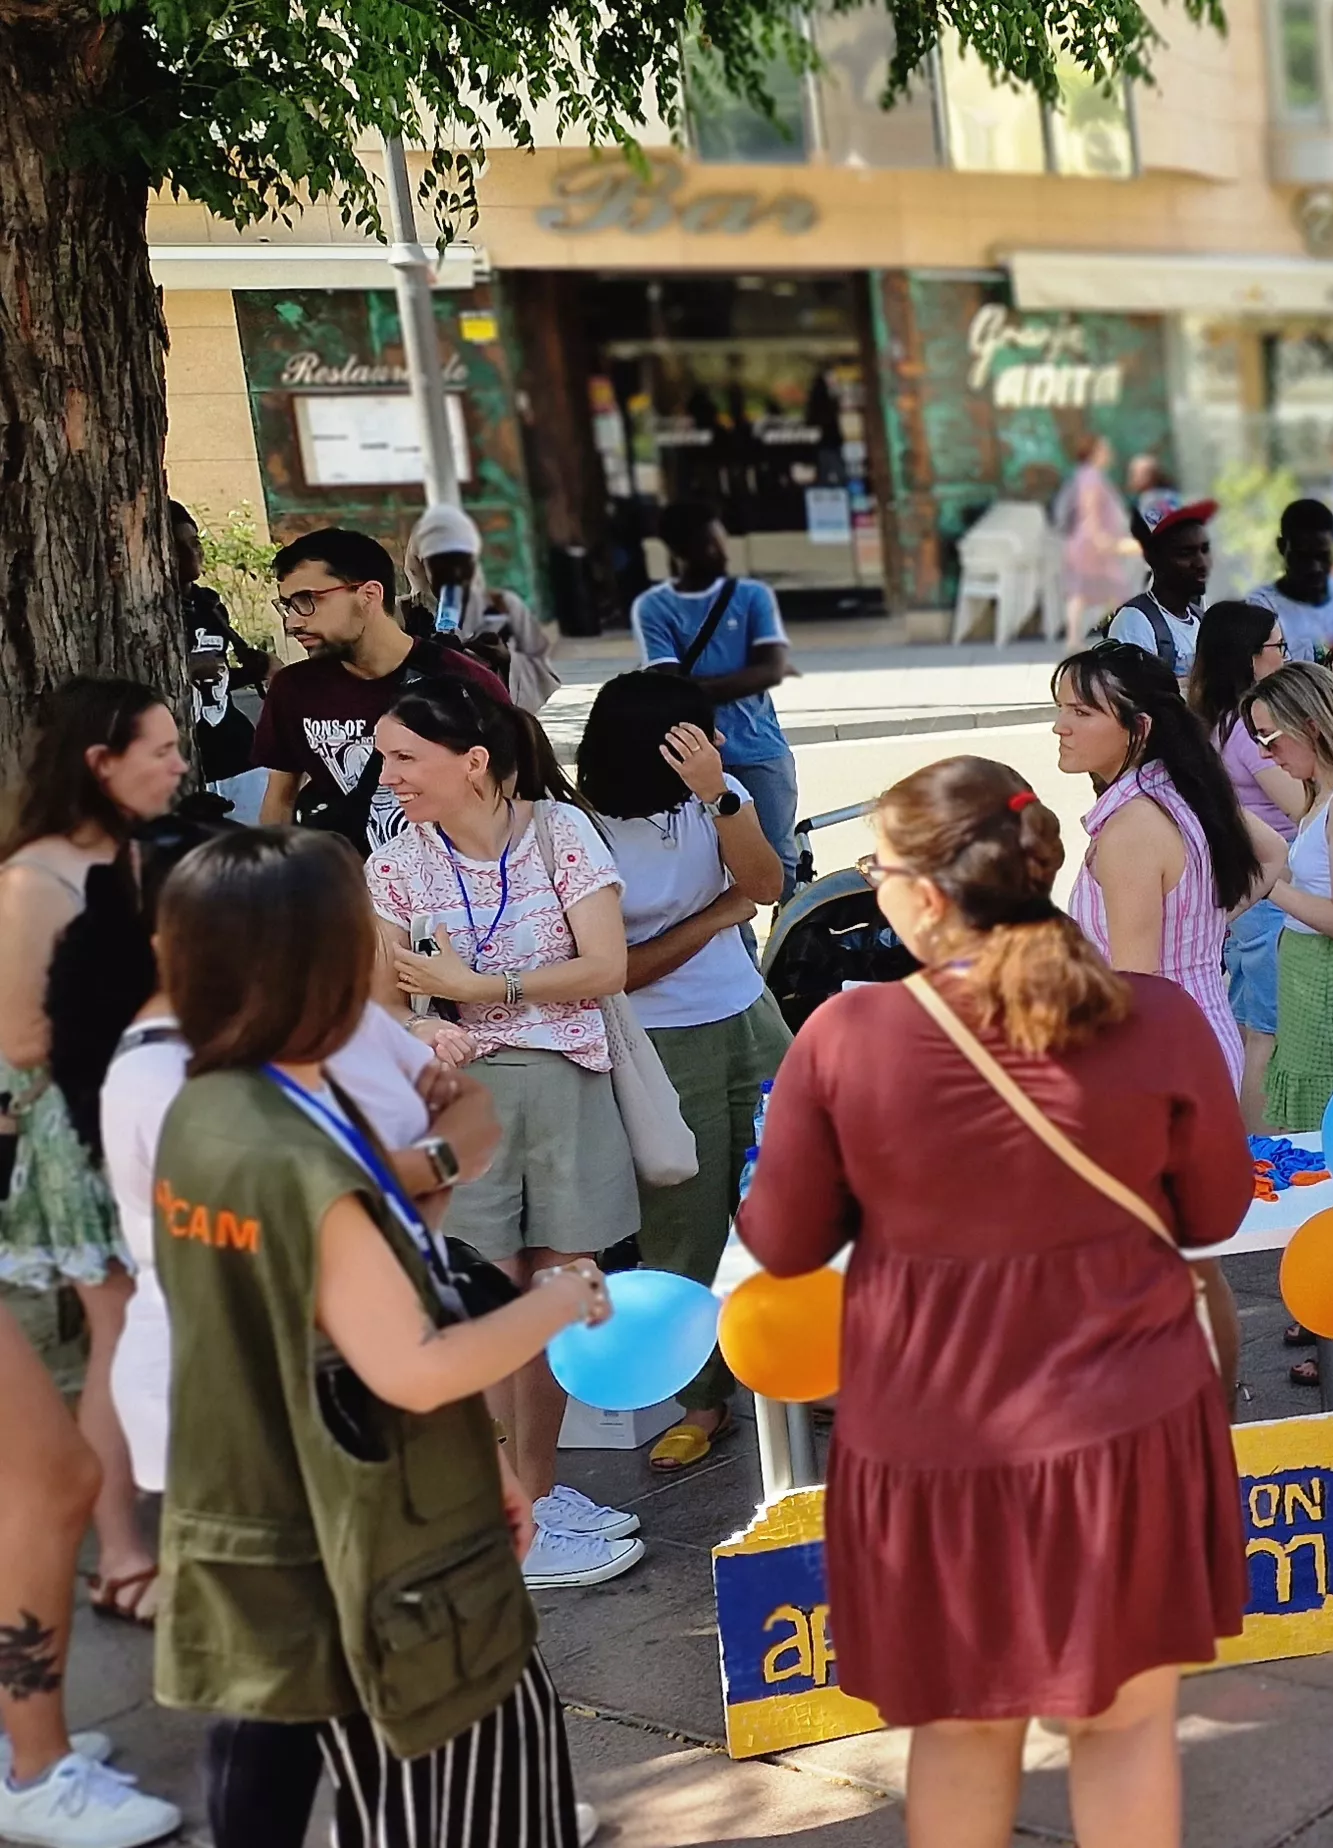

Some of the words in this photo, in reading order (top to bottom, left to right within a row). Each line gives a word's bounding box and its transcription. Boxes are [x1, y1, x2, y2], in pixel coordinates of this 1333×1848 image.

[536, 153, 819, 235] Bar
[281, 351, 468, 385] Restaurte
[303, 717, 340, 750] SONS
[345, 719, 367, 737] OF
